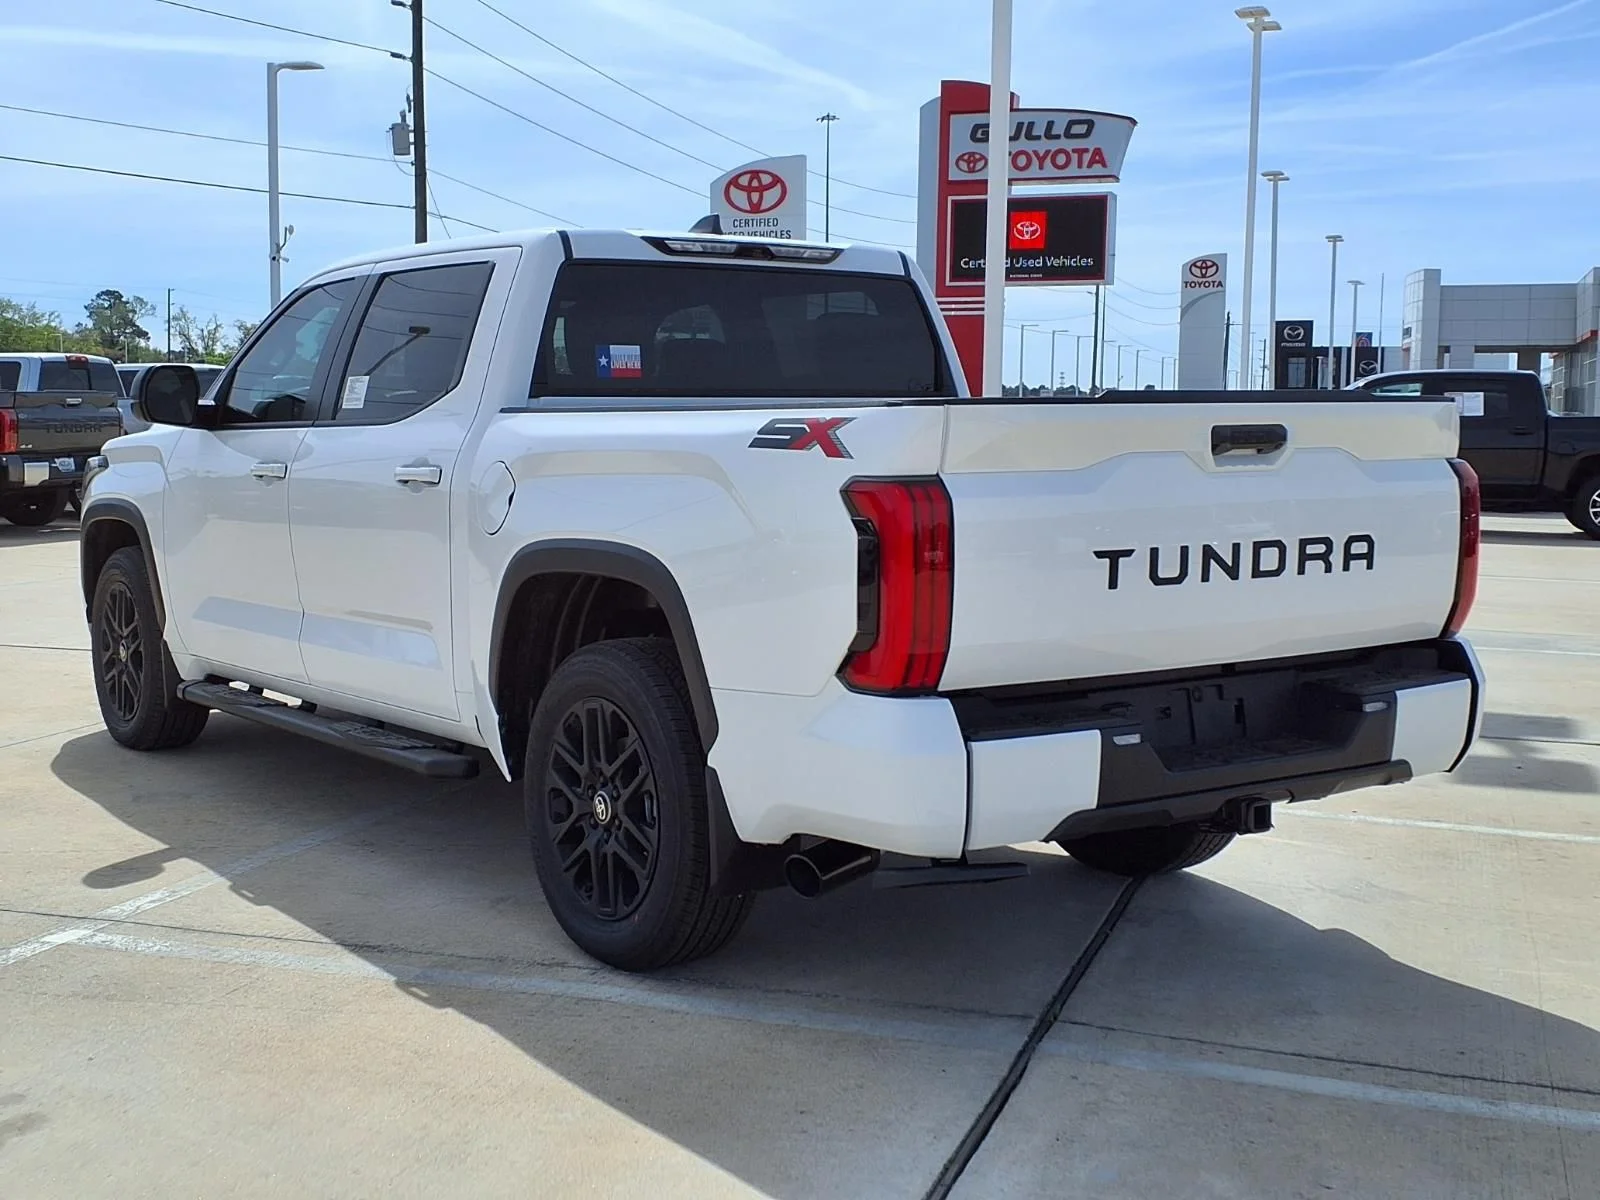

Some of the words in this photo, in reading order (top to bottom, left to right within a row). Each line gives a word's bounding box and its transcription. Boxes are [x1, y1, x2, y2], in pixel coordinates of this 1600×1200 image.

[969, 118, 1096, 144] GULLO
[1009, 147, 1108, 172] OYOTA
[733, 217, 779, 228] CERTIFIED
[1013, 255, 1043, 268] Used
[1045, 254, 1094, 267] Vehicles
[1183, 280, 1224, 289] TOYOTA
[46, 424, 102, 433] TUNDRA
[1093, 534, 1375, 590] TUNDRA
